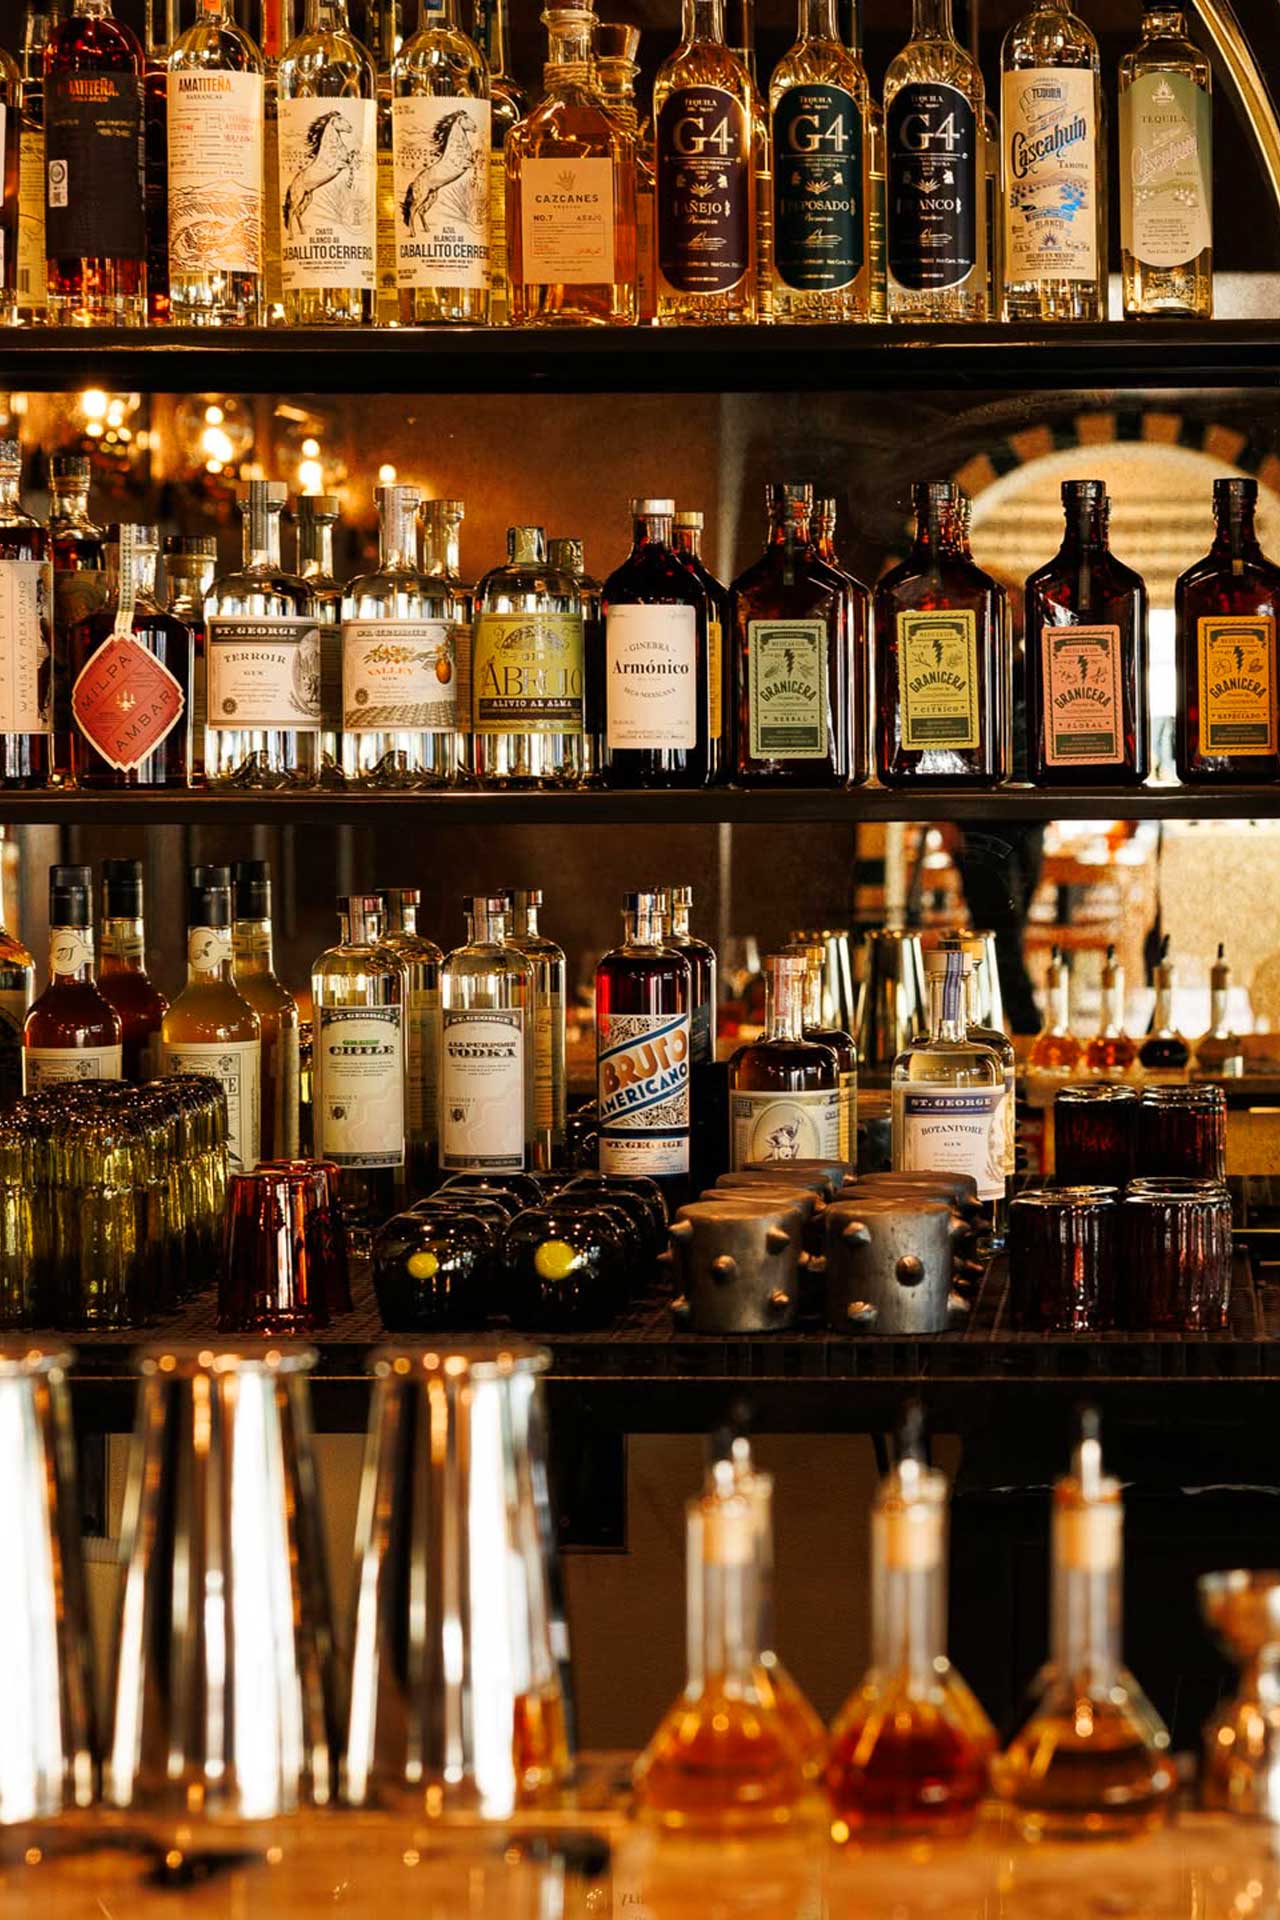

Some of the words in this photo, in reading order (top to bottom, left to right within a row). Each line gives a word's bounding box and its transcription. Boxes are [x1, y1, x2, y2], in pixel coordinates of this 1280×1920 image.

[1142, 115, 1188, 124] TEQUILA
[673, 115, 734, 156] G4
[788, 113, 849, 153] G4
[900, 112, 961, 151] G4
[535, 194, 599, 203] CAZCANES
[400, 244, 452, 258] CABALLITO
[215, 626, 234, 635] ST.
[237, 626, 297, 636] GEORGE
[224, 652, 287, 664] TERROIR
[612, 658, 690, 675] Armónico
[81, 654, 132, 711] MILPA
[759, 680, 817, 702] GRANICERA
[908, 671, 967, 694] GRANICERA
[1209, 677, 1267, 699] GRANICERA
[492, 700, 527, 708] ALIVIO
[530, 700, 544, 708] AL
[547, 700, 573, 708] ALMA
[1054, 686, 1112, 709] GRANICERA
[115, 689, 174, 753] AMBAR
[328, 1045, 395, 1056] CHILE
[448, 1048, 518, 1058] VODKA
[603, 1030, 688, 1095] BRUTO
[601, 1062, 688, 1117] AMERICANO
[911, 1098, 933, 1108] ST.
[935, 1098, 992, 1107] GEORGE
[920, 1124, 984, 1136] BOTANIVORE
